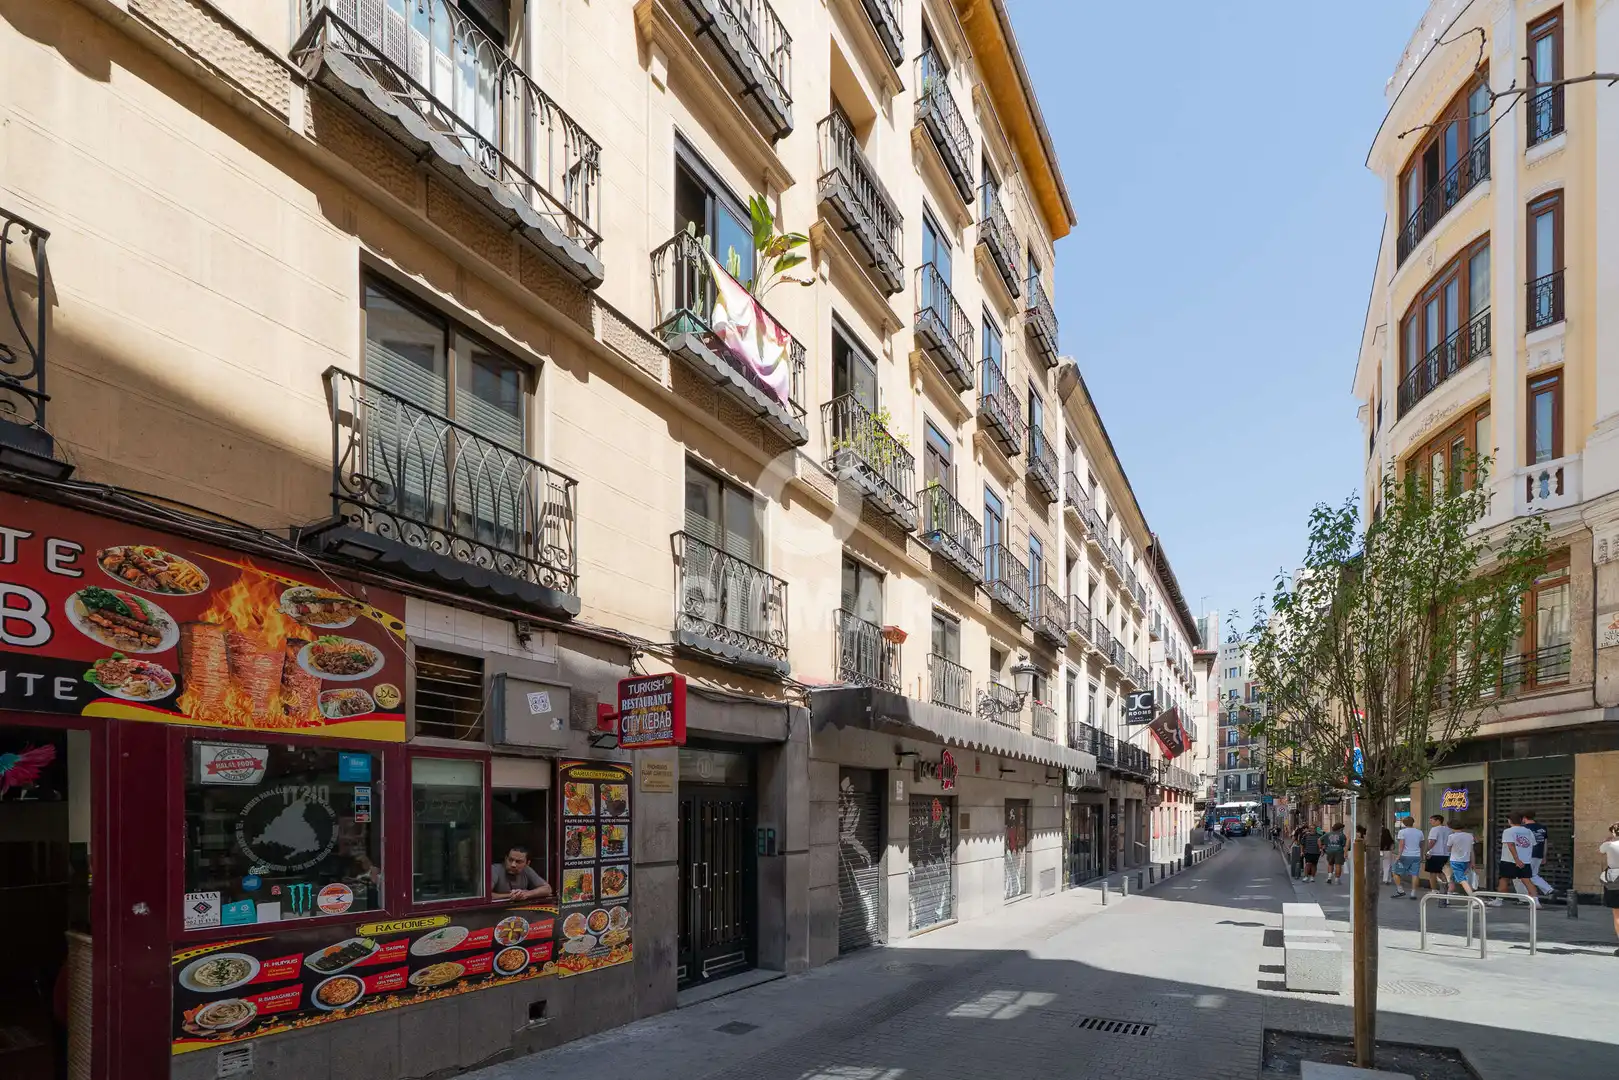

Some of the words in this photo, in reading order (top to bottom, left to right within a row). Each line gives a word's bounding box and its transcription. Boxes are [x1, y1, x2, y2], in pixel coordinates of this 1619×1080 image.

[0, 669, 79, 702] TE
[627, 678, 665, 695] TURKISH
[621, 692, 672, 711] RESTAURANTE
[1129, 693, 1152, 711] JC
[621, 714, 641, 733] CITY
[642, 710, 672, 730] KEBAB
[215, 761, 236, 769] HALAL
[237, 759, 254, 768] FOOD
[375, 917, 435, 932] RACIONES
